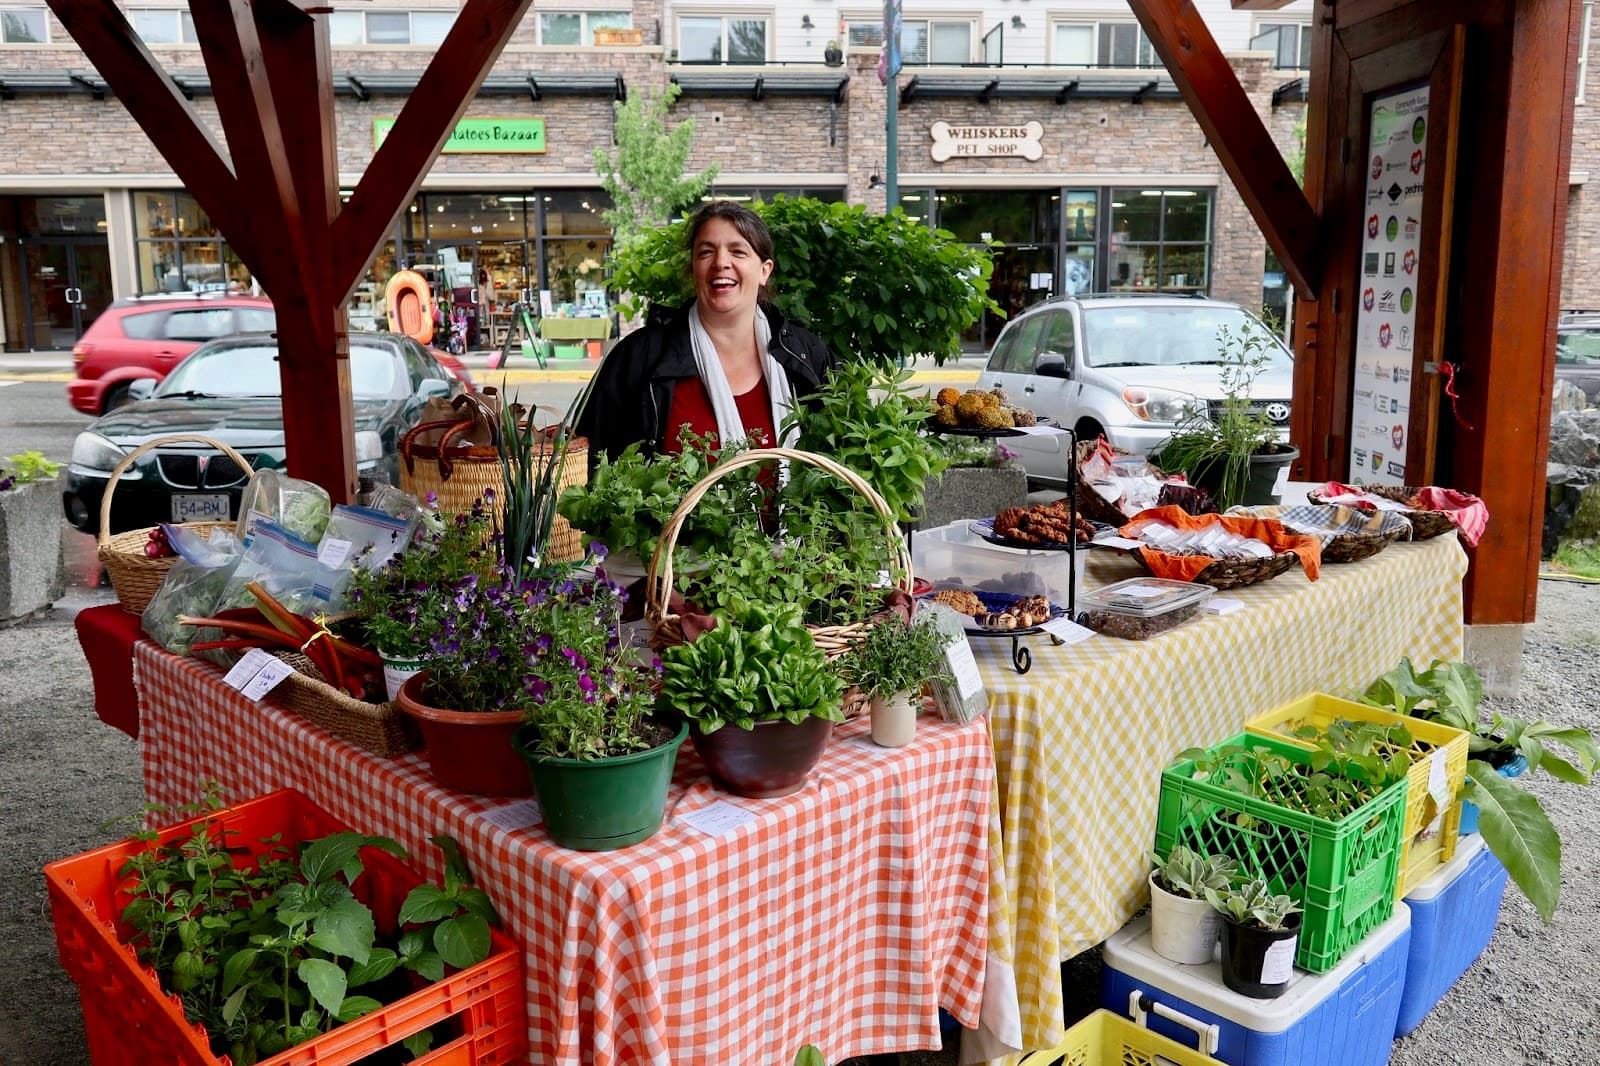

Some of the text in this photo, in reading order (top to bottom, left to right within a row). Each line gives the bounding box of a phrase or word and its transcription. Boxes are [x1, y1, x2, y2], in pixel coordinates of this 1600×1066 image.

[493, 126, 539, 140] Bazaar
[947, 128, 1028, 139] WHISKERS
[957, 144, 1018, 154] PET SHOP
